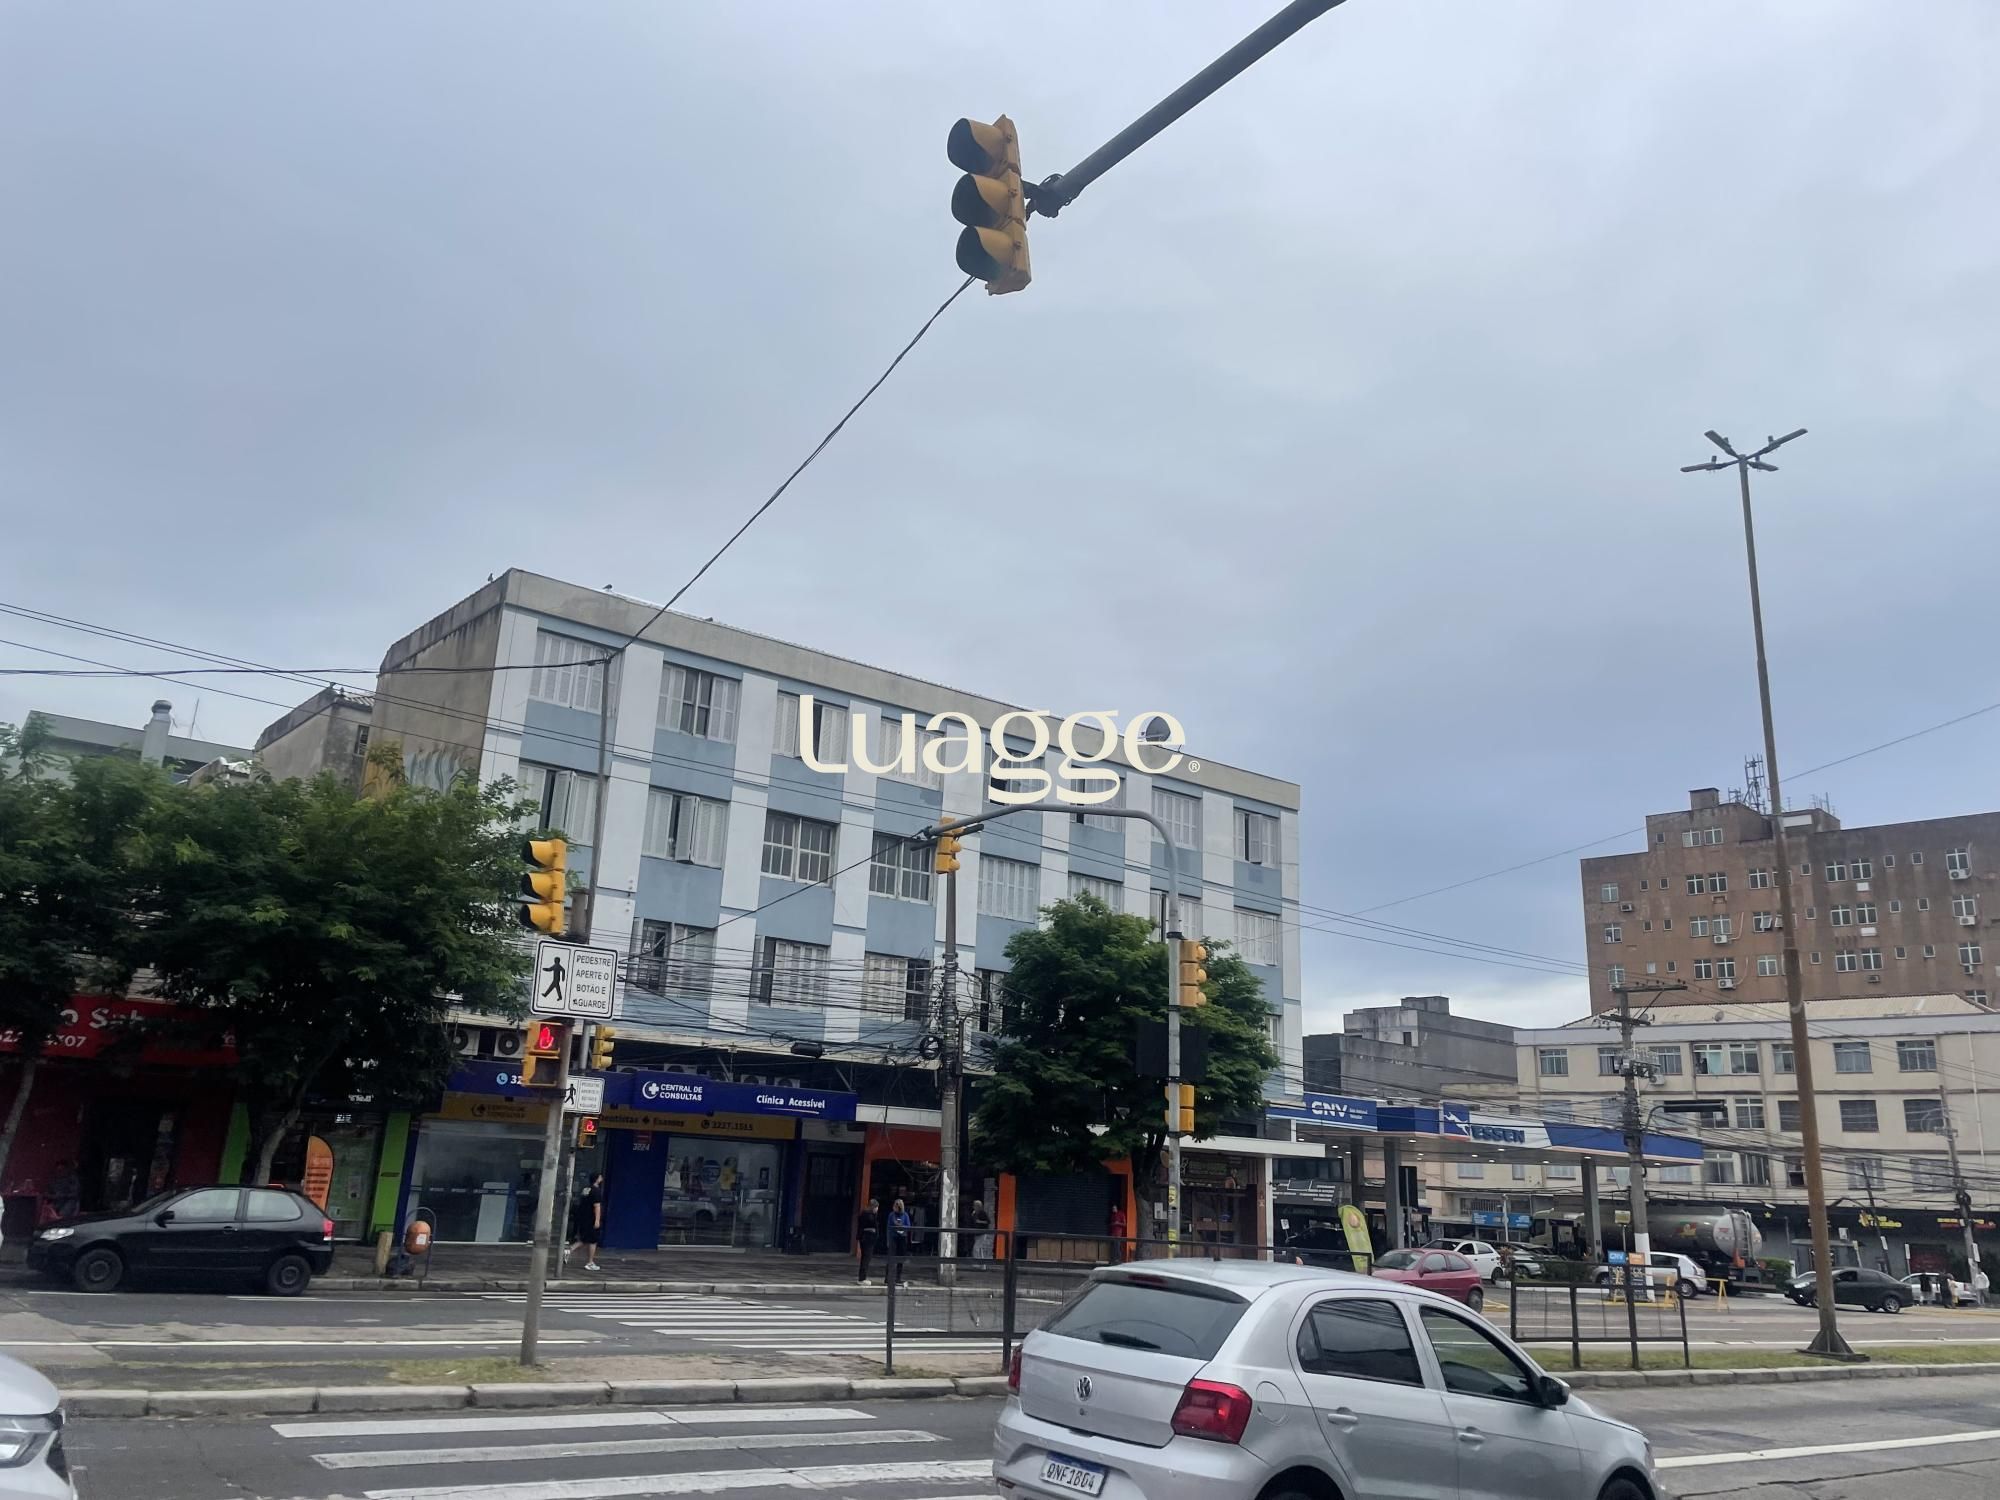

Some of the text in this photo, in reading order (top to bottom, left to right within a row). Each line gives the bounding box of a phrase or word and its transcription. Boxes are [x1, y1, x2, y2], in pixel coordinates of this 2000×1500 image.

[576, 955, 611, 967] PEDESTRE
[575, 969, 609, 981] APERTE O
[601, 986, 606, 995] E
[573, 998, 606, 1010] AGUARDE
[660, 1083, 703, 1094] CENTRAL DE
[659, 1092, 703, 1101] CONSULTAS
[756, 1095, 826, 1109] Clínica Acessível
[1311, 1101, 1348, 1118] GNV
